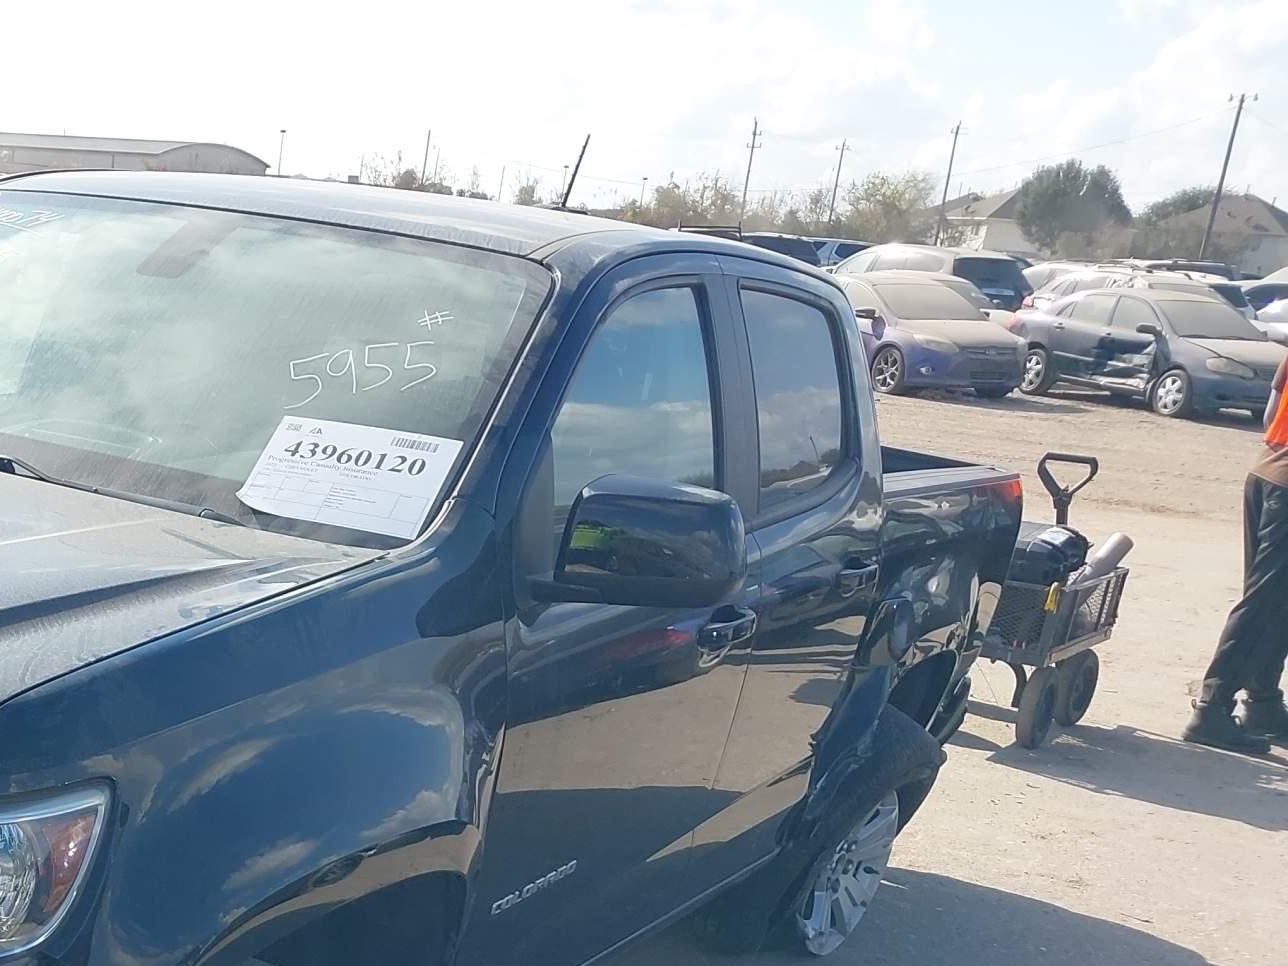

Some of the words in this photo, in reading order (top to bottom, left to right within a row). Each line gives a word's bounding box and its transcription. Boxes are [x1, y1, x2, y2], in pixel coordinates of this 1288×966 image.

[283, 341, 437, 409] 5955
[283, 439, 426, 477] 43960120
[490, 859, 577, 915] COLORADO
